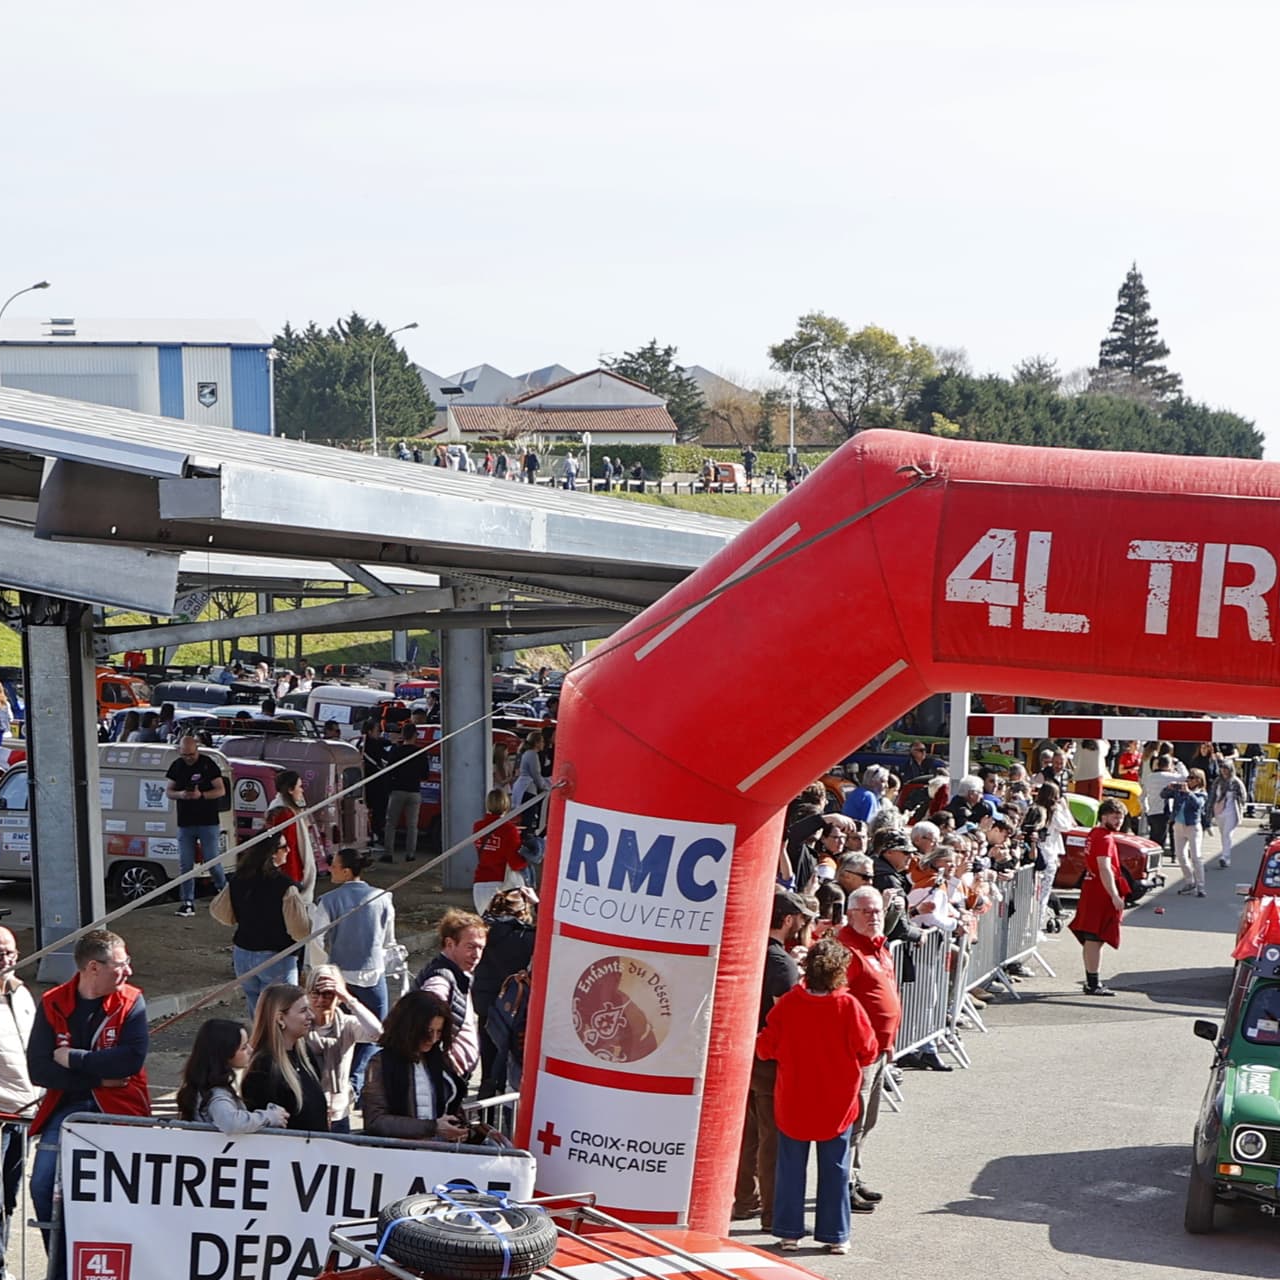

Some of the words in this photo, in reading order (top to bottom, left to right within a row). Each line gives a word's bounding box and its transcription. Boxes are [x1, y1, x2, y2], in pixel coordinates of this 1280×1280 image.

[945, 528, 1089, 633] 4L
[566, 819, 727, 902] RMC
[559, 888, 715, 932] DÉCOUVERTE
[578, 960, 625, 994] Enfants
[629, 961, 648, 979] du
[647, 972, 673, 1017] Désert
[567, 1148, 668, 1174] FRANÇAISE
[570, 1129, 686, 1157] CROIX-ROUGE
[71, 1142, 270, 1211] ENTRÉE
[86, 1254, 116, 1274] 4L
